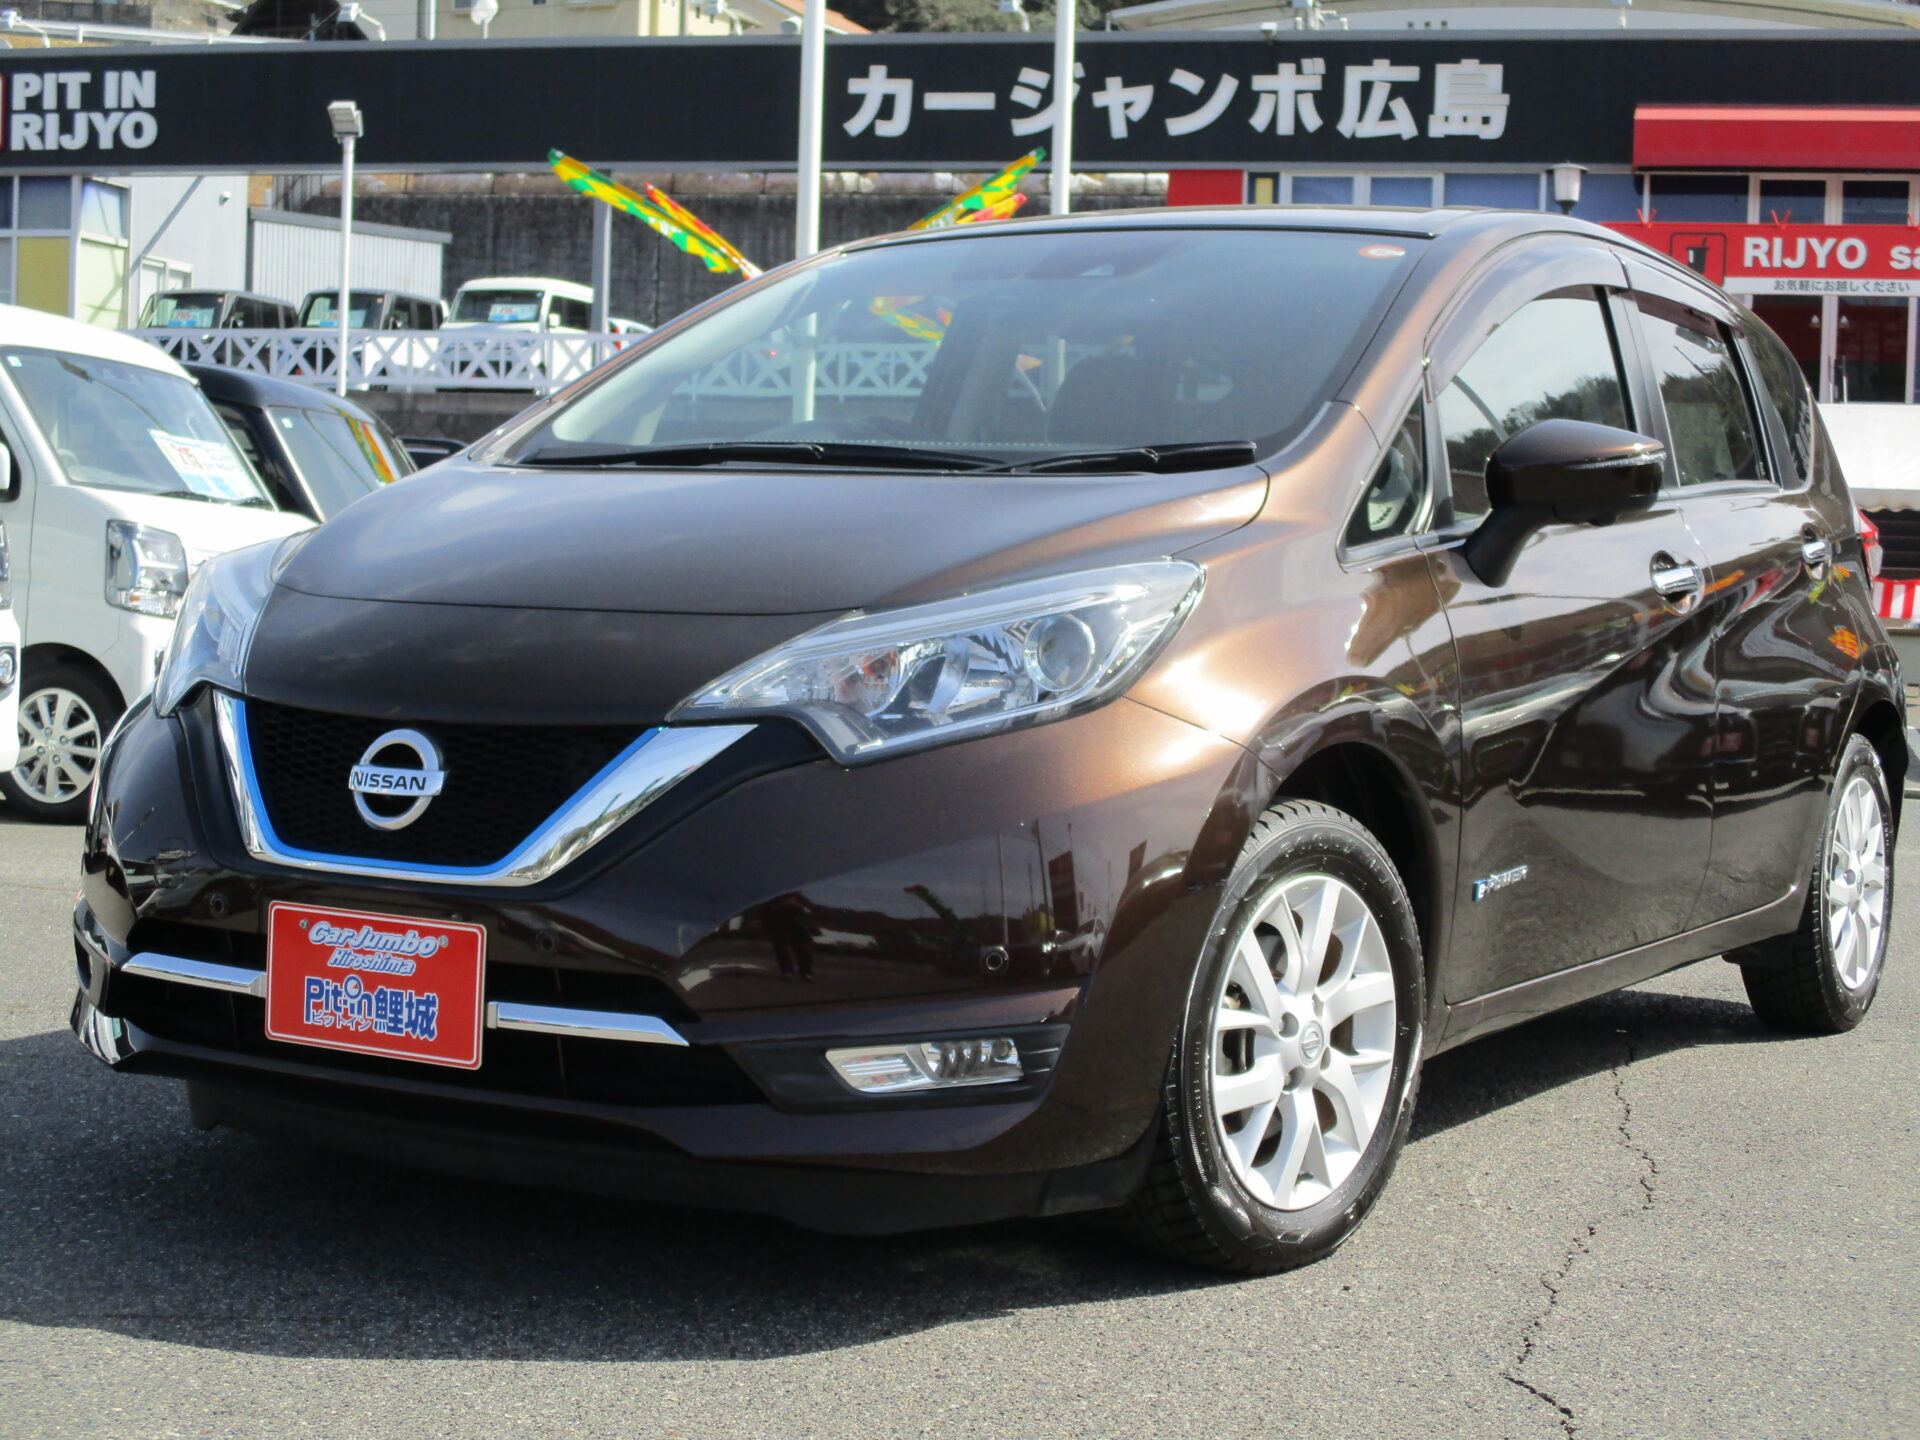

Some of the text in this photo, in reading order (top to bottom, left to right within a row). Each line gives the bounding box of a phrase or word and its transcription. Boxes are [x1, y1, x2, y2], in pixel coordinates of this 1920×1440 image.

[12, 70, 156, 110] PIT IN
[843, 57, 1511, 141] カージャンボ広島
[11, 111, 158, 150] RIJYO
[1743, 236, 1868, 270] RIJYO
[1774, 279, 1911, 293] お気軽にお越しください
[353, 771, 427, 791] NISSAN
[327, 948, 416, 976] Hiroshima
